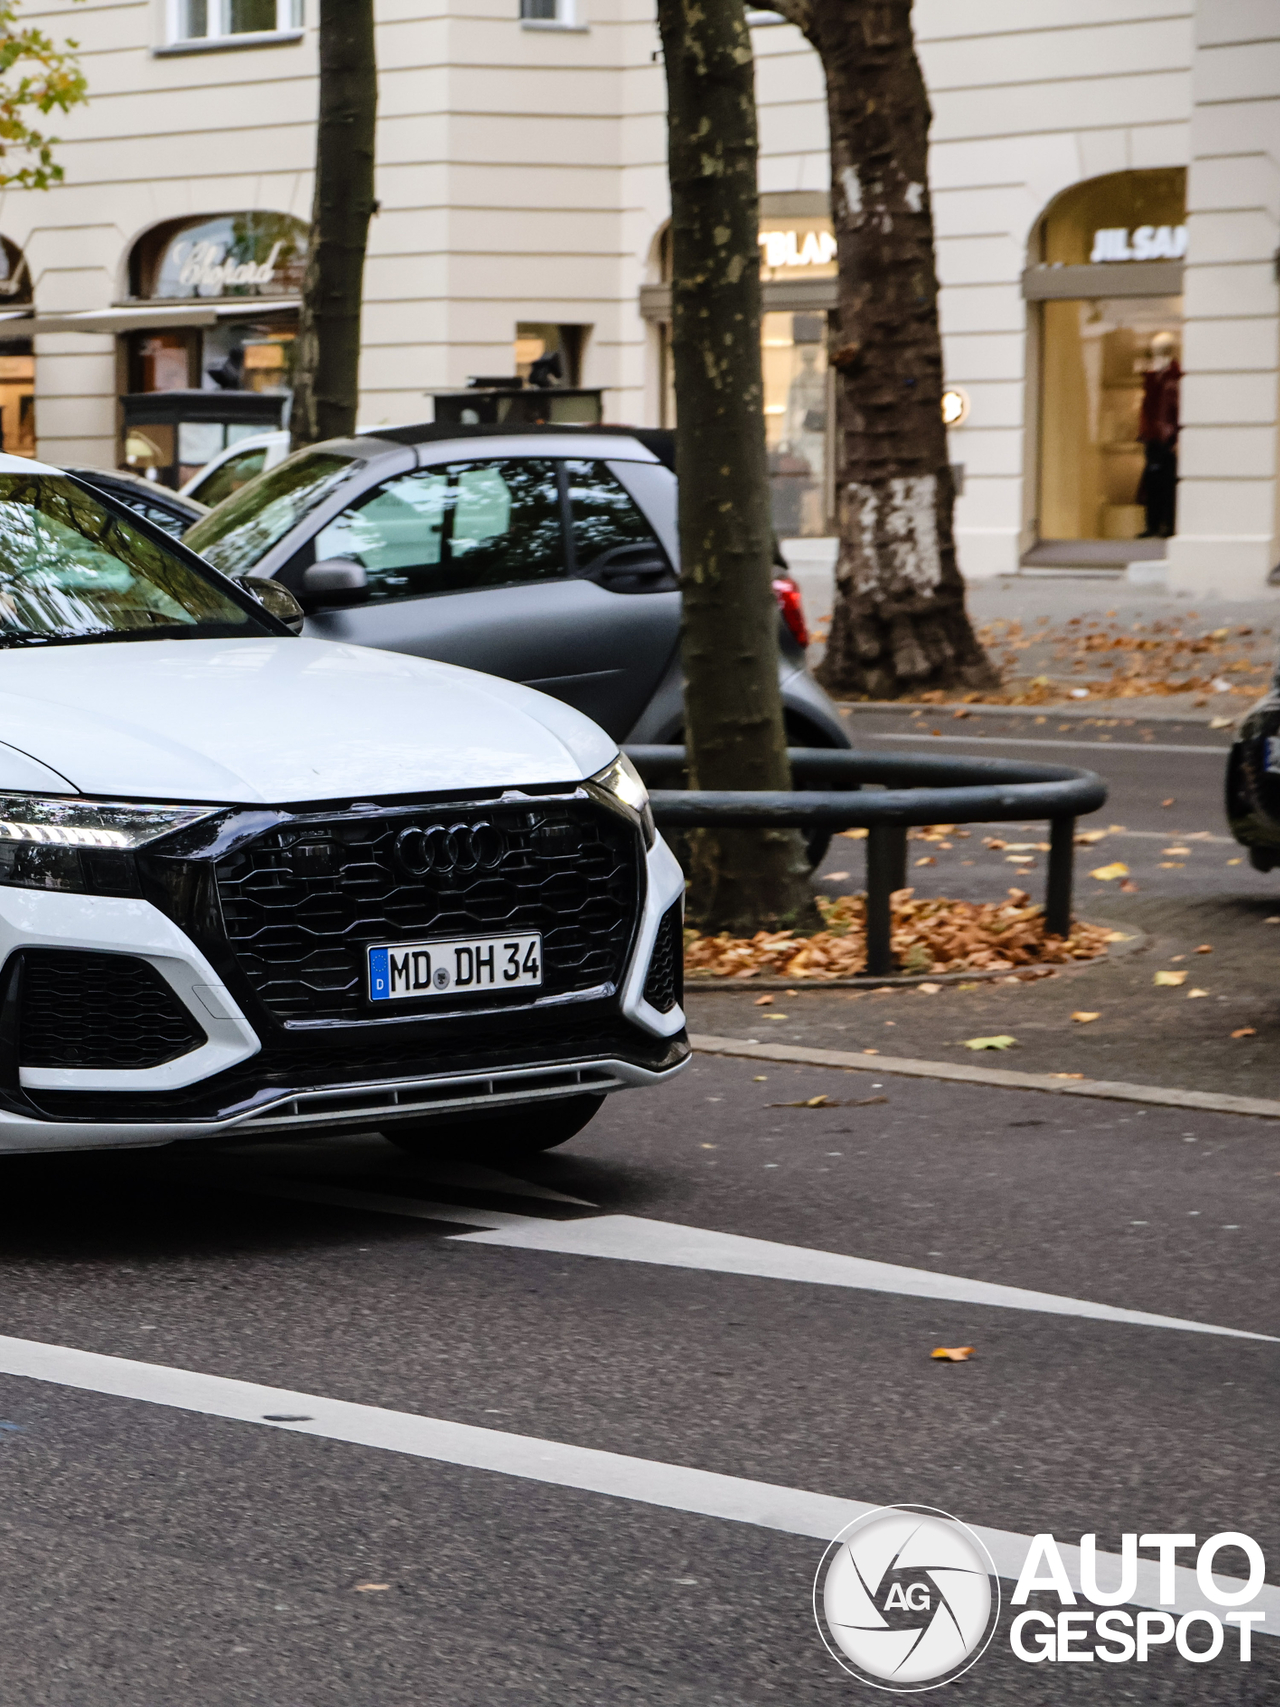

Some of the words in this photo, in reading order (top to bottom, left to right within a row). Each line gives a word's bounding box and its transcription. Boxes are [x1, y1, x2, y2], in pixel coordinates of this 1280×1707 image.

[172, 240, 287, 297] Chopard
[376, 978, 384, 991] D
[389, 950, 432, 992] MD
[454, 944, 495, 986] DH
[503, 940, 539, 981] 34
